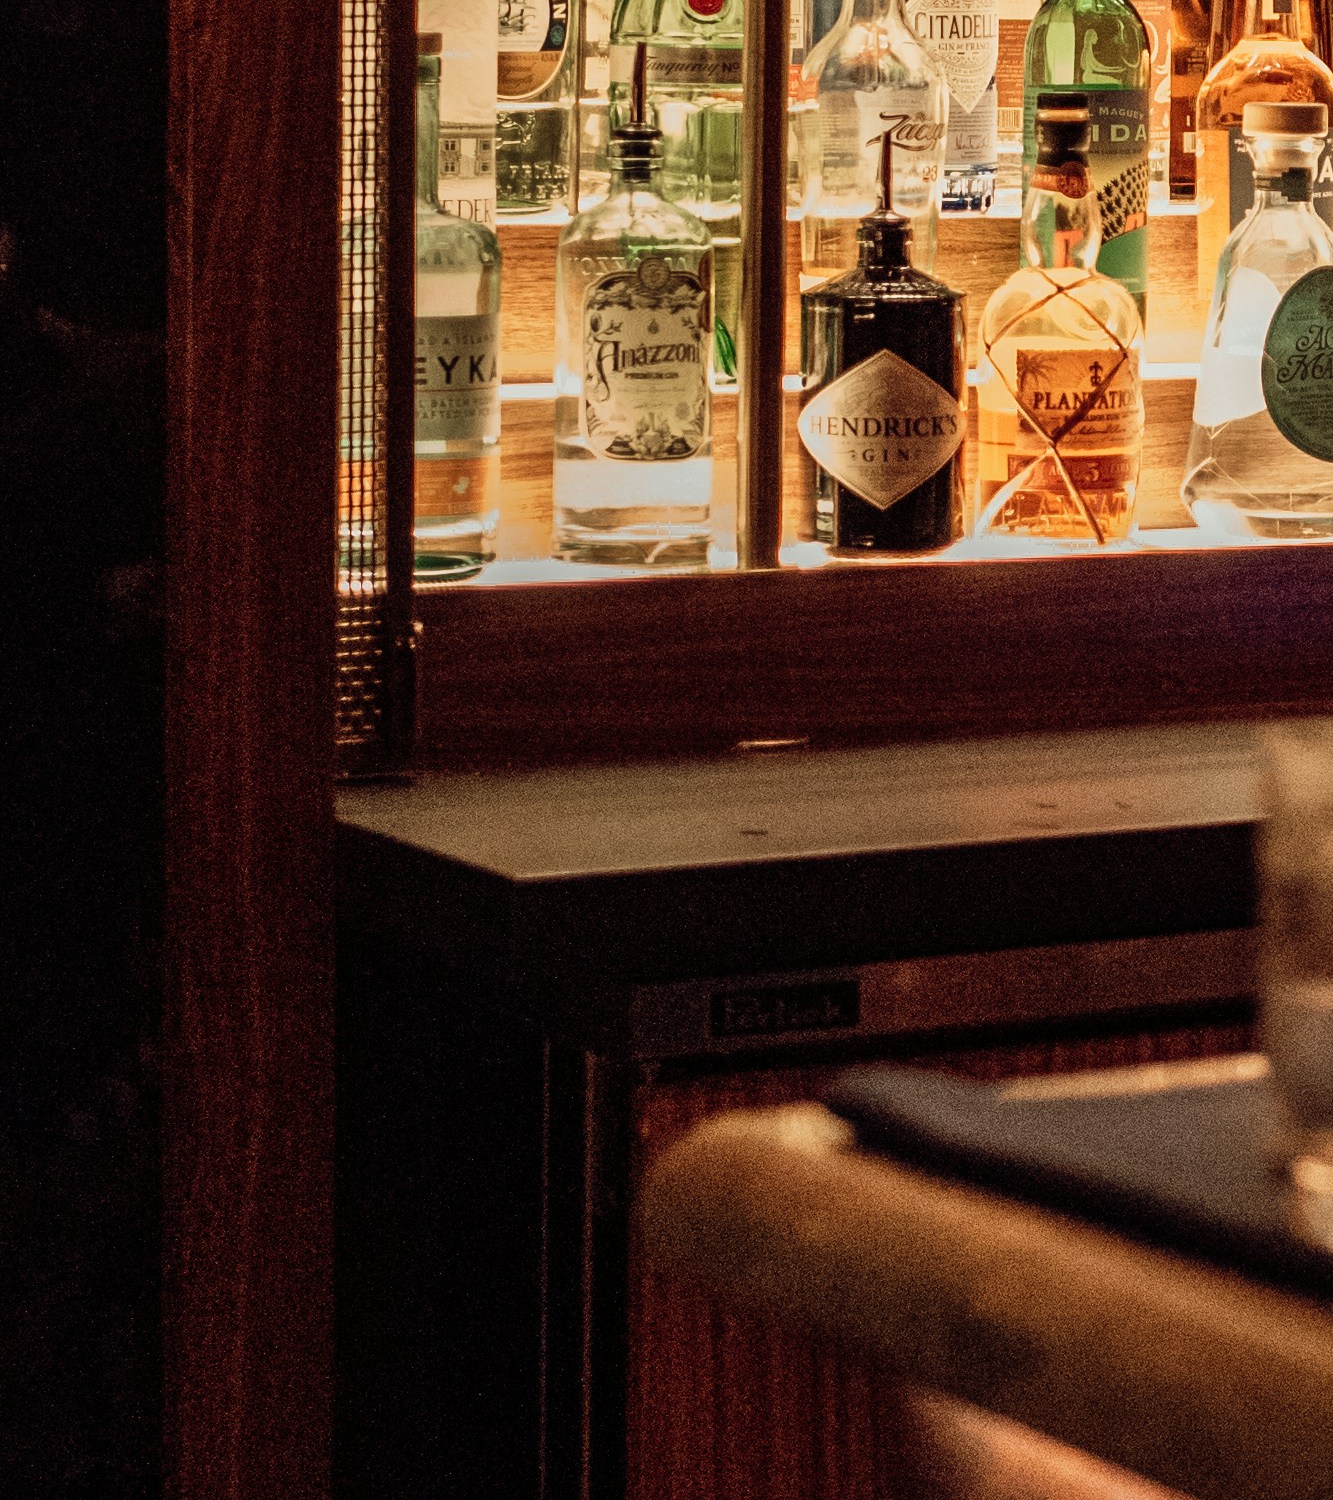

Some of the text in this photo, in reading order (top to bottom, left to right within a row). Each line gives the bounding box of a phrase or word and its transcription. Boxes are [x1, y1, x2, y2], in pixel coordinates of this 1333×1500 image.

[938, 42, 955, 51] GIN
[1098, 105, 1144, 120] MAGUEY
[1091, 124, 1147, 143] IDA
[810, 415, 959, 438] HENDRICK'S
[862, 448, 911, 464] GIN
